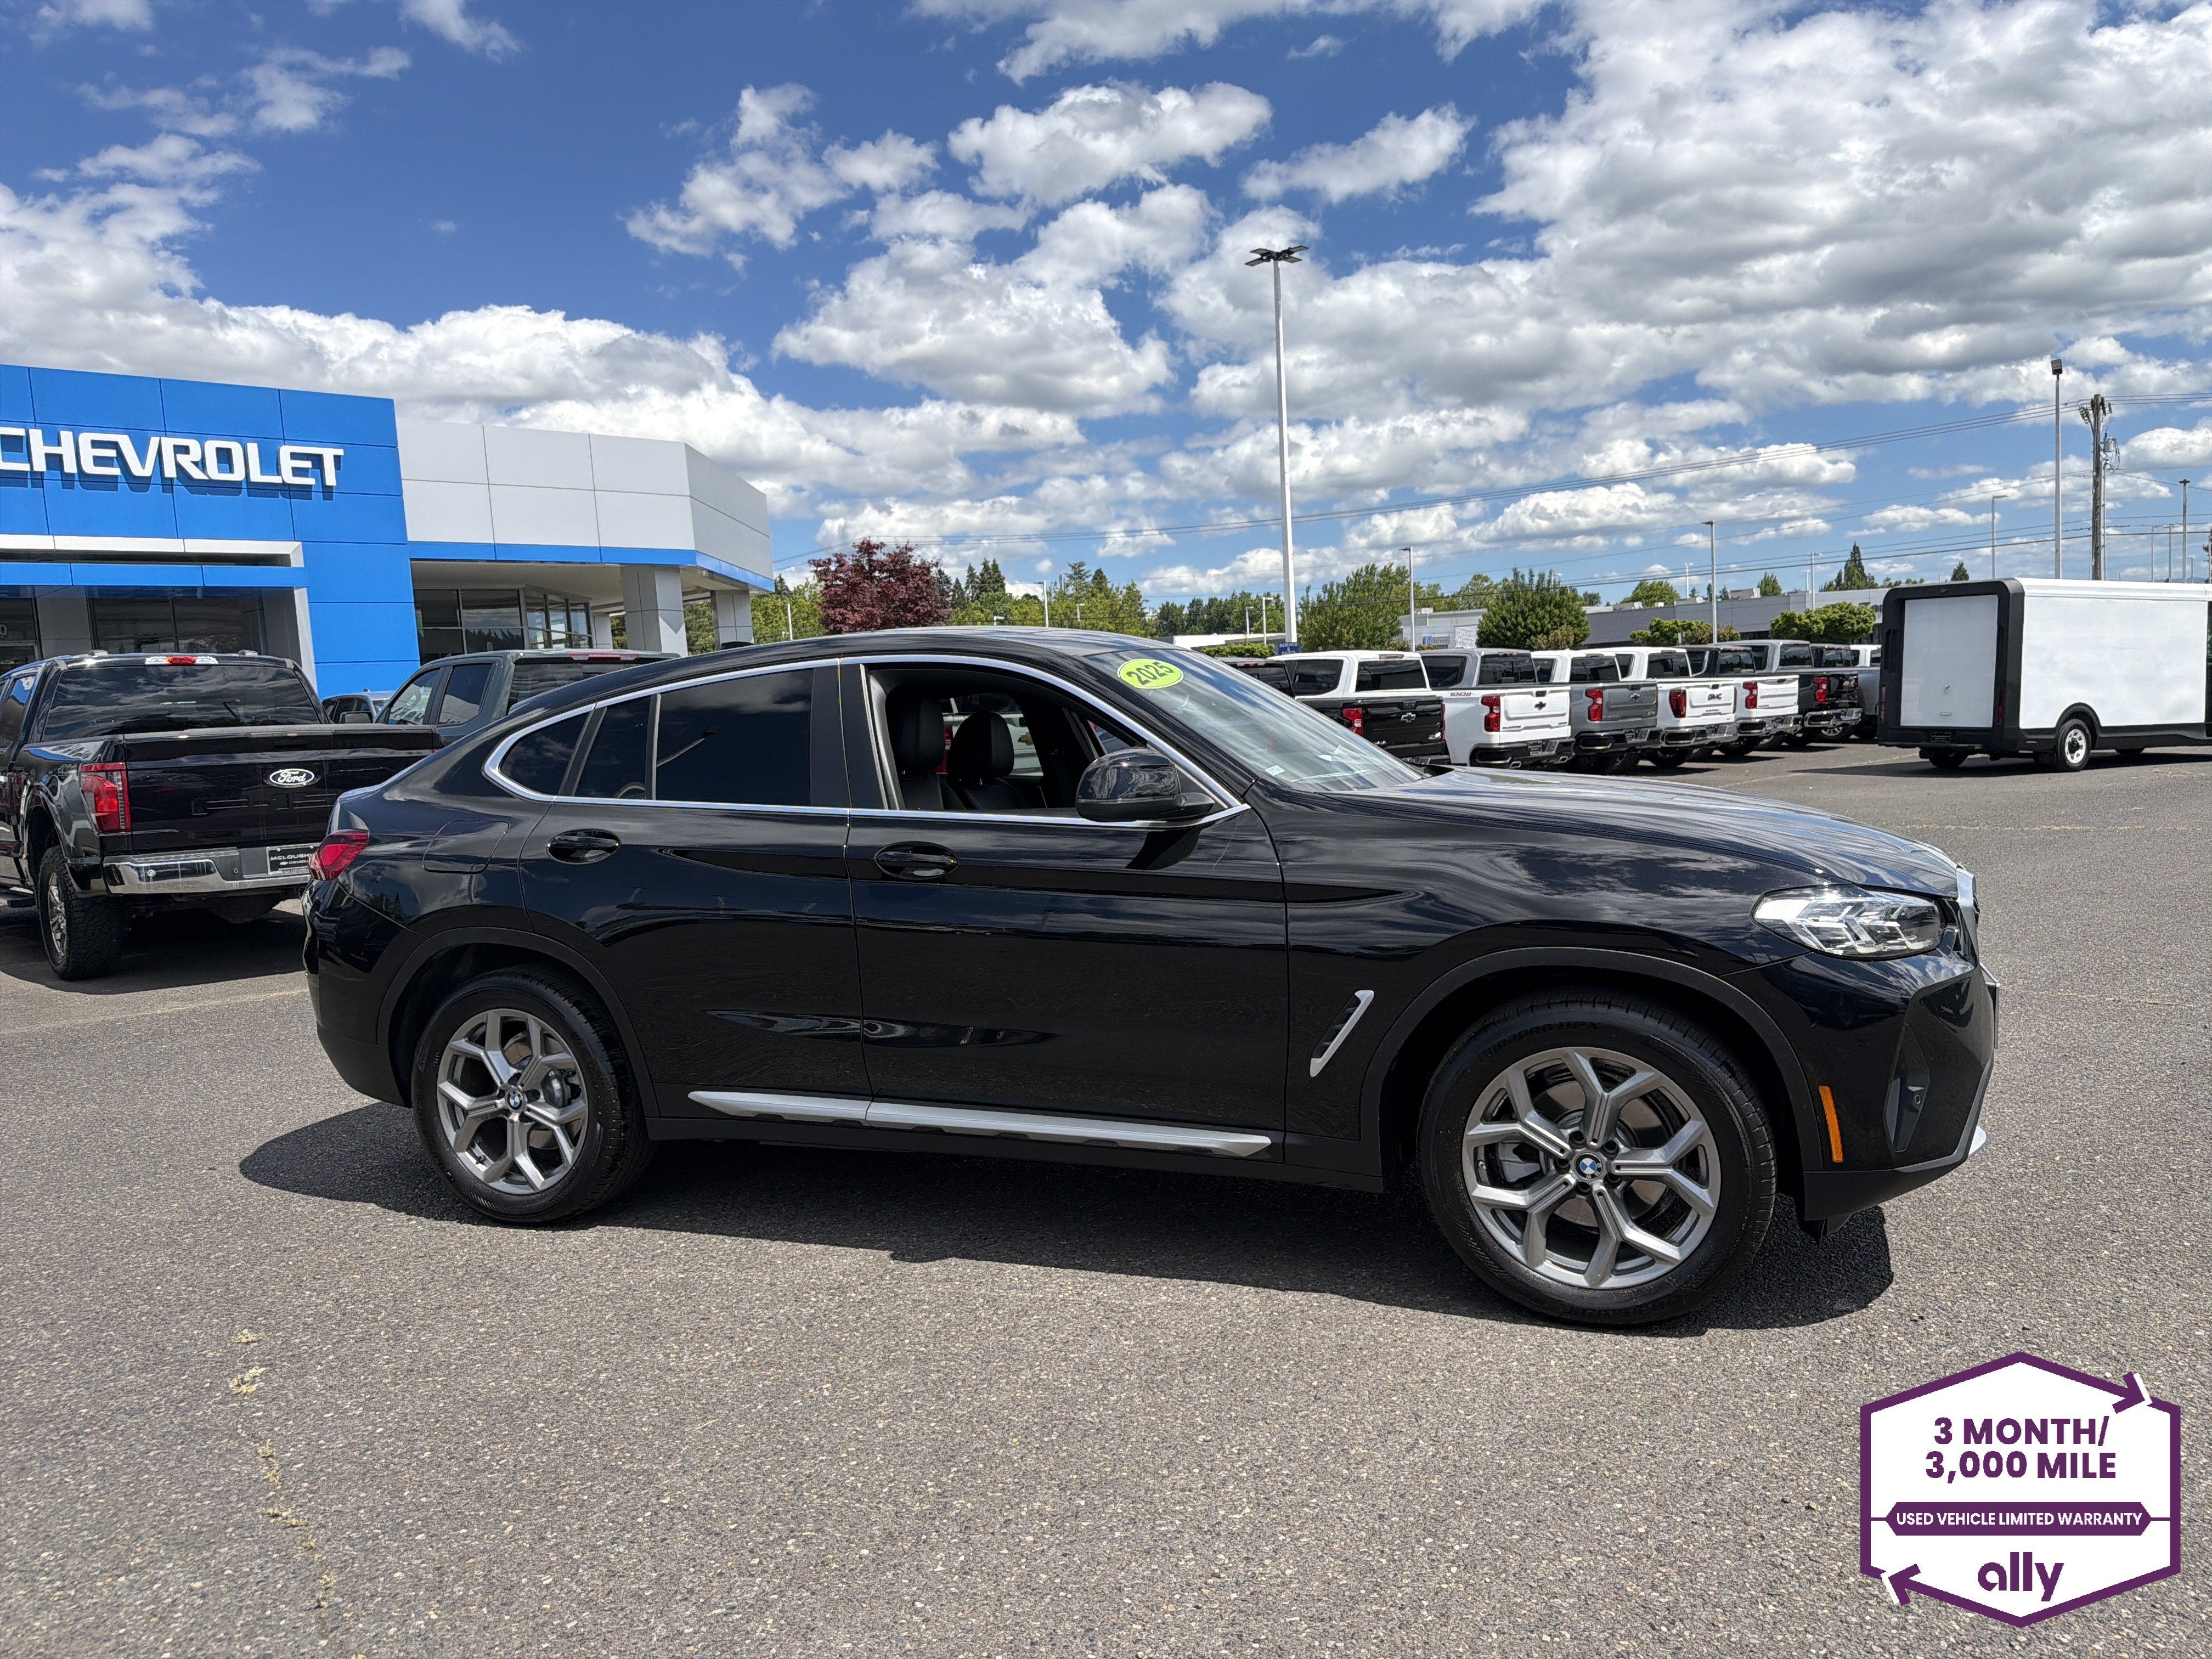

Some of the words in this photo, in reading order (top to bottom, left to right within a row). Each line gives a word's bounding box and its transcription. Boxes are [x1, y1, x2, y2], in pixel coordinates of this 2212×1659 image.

[0, 427, 344, 487] CHEVROLET
[1126, 662, 1173, 685] 2025
[278, 771, 306, 783] Ford
